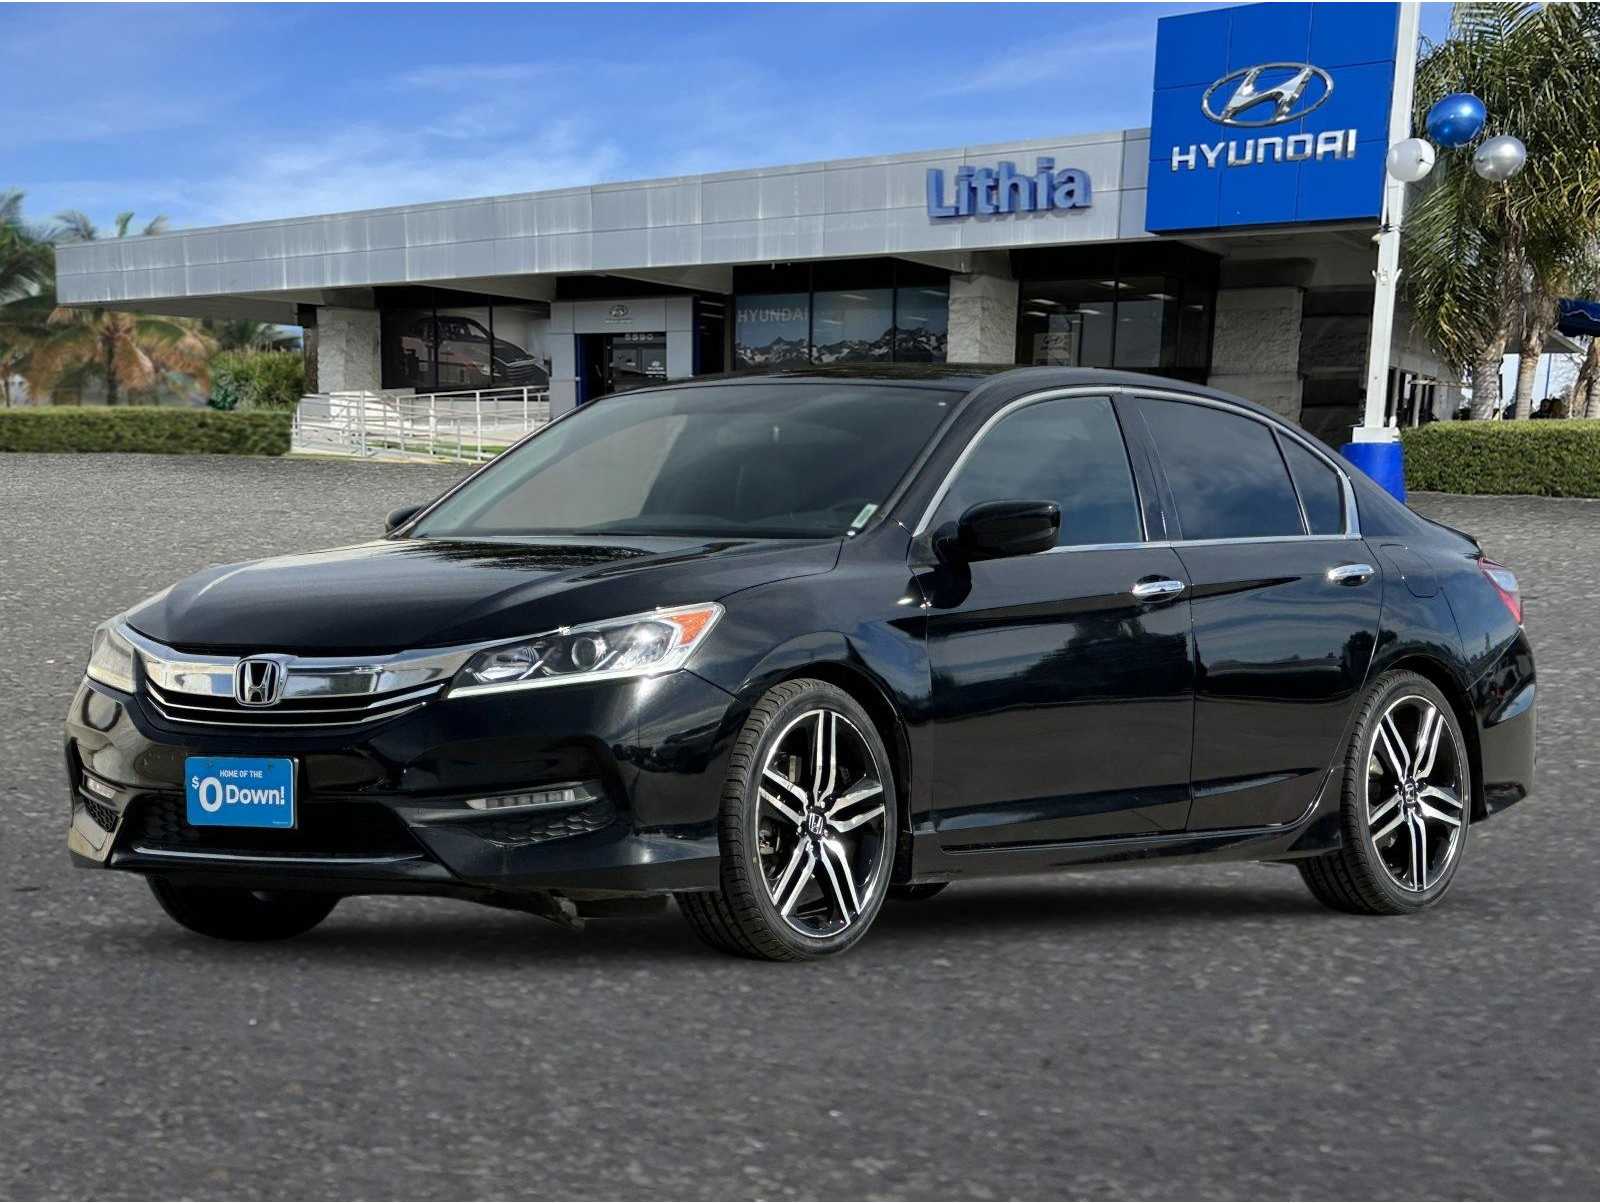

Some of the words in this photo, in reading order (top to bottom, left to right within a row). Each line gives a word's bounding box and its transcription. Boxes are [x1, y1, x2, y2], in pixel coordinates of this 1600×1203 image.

[1170, 129, 1357, 172] HYUNDAI
[926, 157, 1092, 217] Lithia
[737, 307, 809, 322] HYUNDAI
[219, 769, 238, 778] HOME
[239, 769, 248, 778] OF
[249, 769, 264, 778] THE
[225, 784, 285, 805] Down!
